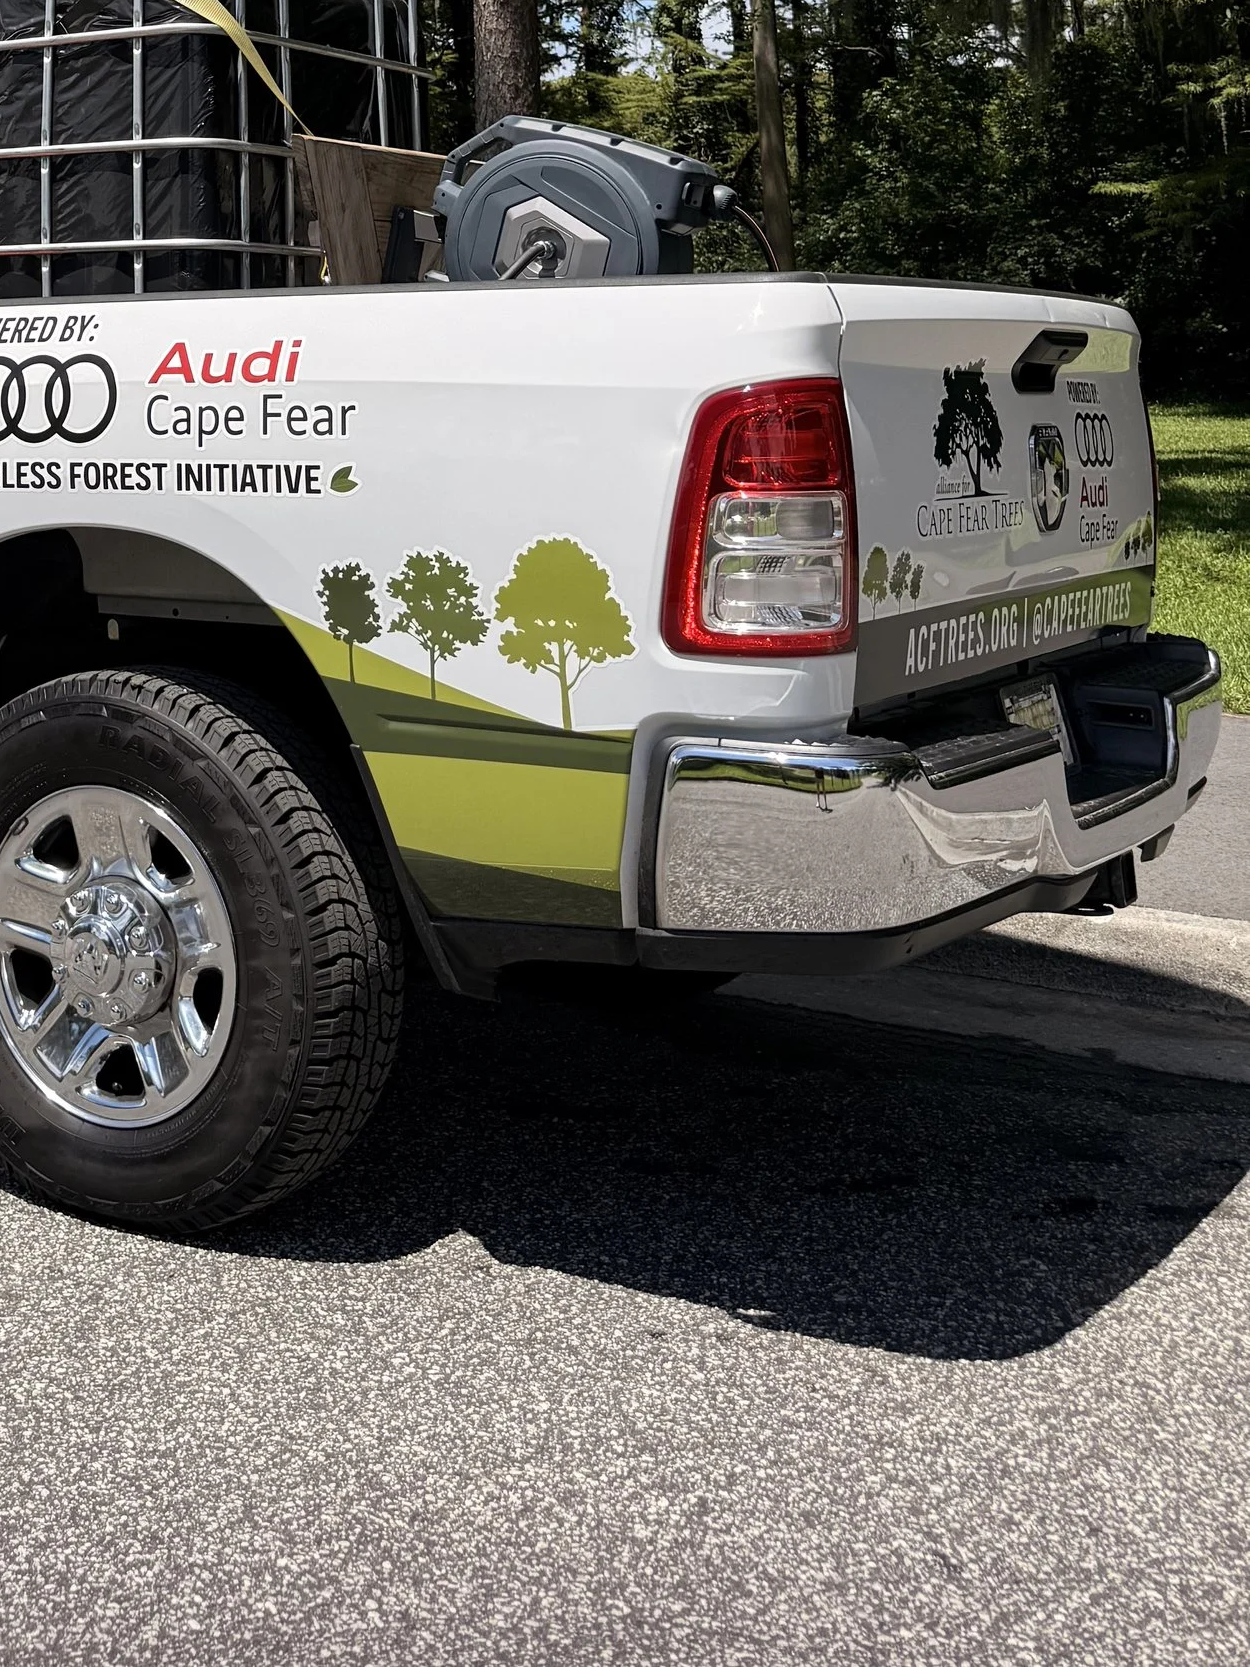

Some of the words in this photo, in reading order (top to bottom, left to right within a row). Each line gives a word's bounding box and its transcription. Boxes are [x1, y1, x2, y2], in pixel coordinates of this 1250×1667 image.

[57, 314, 100, 344] BY:
[148, 339, 303, 385] Audi
[148, 394, 245, 447] Cape
[261, 394, 357, 437] Fear
[69, 462, 168, 492] FOREST
[175, 463, 322, 495] INITIATIVE
[936, 476, 960, 495] alliance
[1079, 476, 1109, 508] Audi
[917, 505, 953, 537] CAPE
[958, 502, 990, 533] FEAR
[992, 500, 1025, 529] TREES
[1079, 515, 1102, 549] Cape
[1102, 514, 1119, 541] Fear
[905, 603, 1018, 676] ACFTREES.ORG
[1031, 581, 1132, 646] @CAPEFEARTREES
[96, 724, 221, 824] RADIAL
